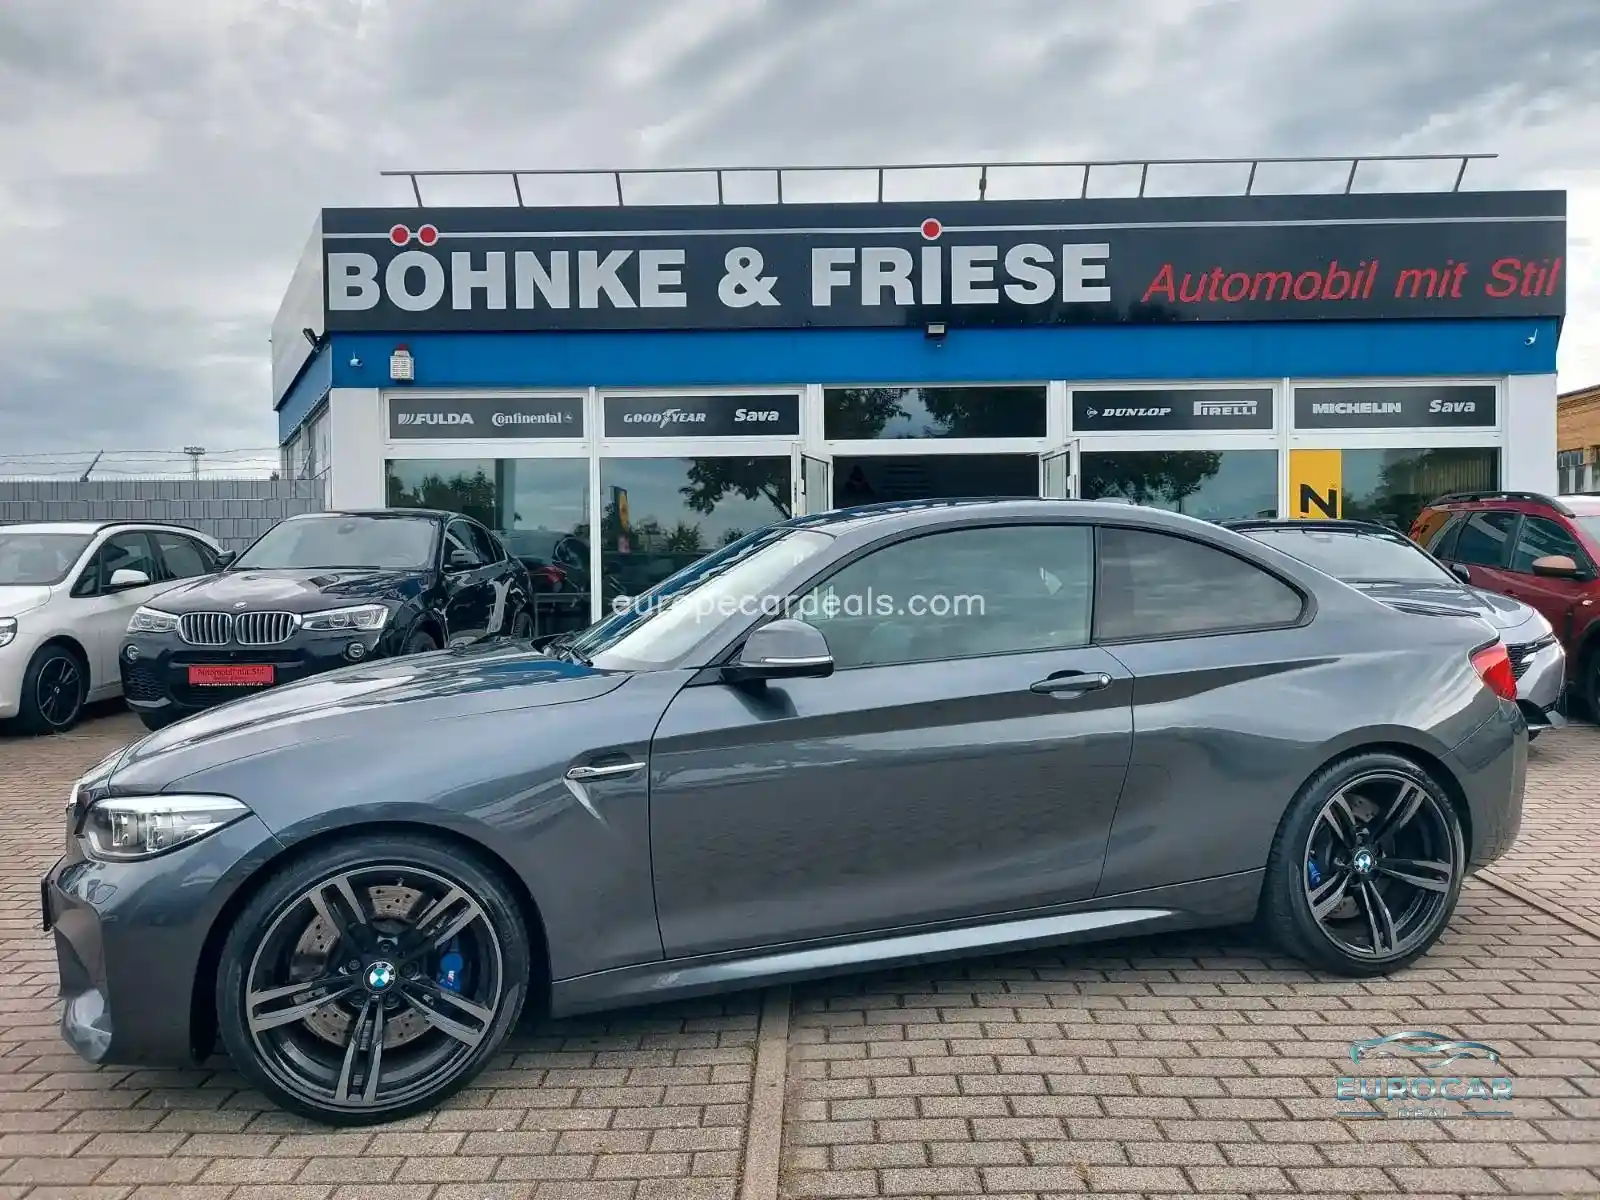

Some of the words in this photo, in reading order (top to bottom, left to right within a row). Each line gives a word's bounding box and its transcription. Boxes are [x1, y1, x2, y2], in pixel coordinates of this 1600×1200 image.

[327, 224, 688, 312] BÖHNKE
[718, 246, 781, 307] &
[811, 219, 1111, 307] FRIESE
[1141, 259, 1378, 303] Automobil
[1394, 259, 1470, 299] mit
[1484, 256, 1564, 298] Stil
[1102, 407, 1172, 417] DUNLOP
[1193, 400, 1258, 415] PIRELLI
[1312, 402, 1402, 414] MICHELIN
[1429, 399, 1476, 413] Sava
[412, 412, 474, 425] FULDA
[491, 412, 562, 427] Continental
[734, 408, 779, 422] Sava
